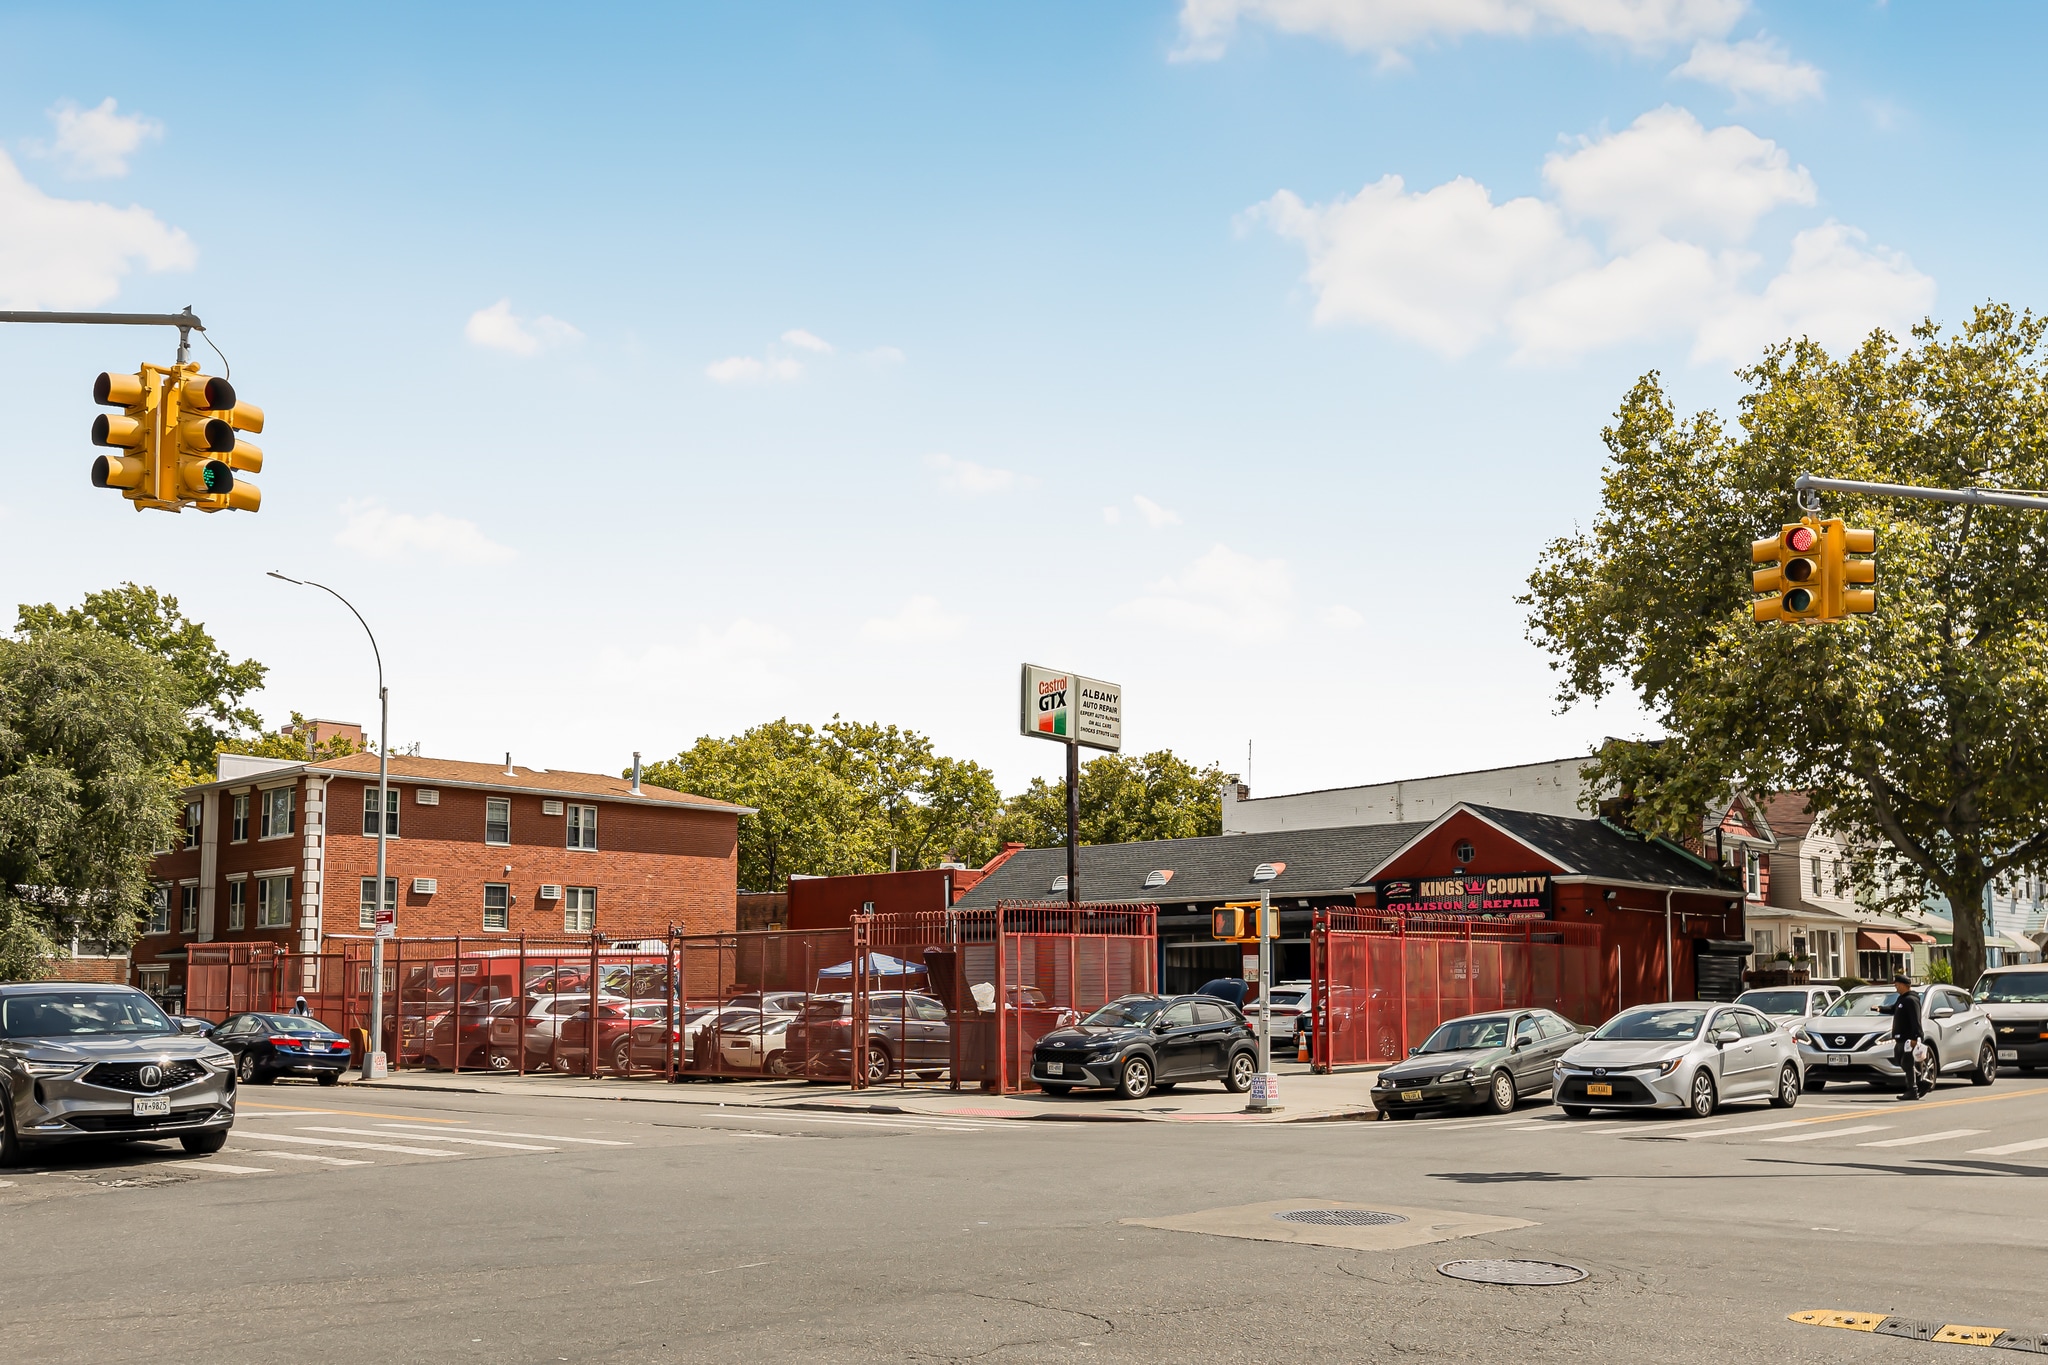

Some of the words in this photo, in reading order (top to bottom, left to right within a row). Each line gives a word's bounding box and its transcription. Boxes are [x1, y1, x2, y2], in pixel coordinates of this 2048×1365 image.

[1039, 676, 1067, 695] Castrol
[1039, 690, 1067, 712] GTX
[1082, 689, 1118, 703] ALBANY
[1083, 701, 1098, 710] AUTO
[1099, 704, 1118, 714] REPAIR
[1080, 726, 1096, 734] SHOCKS
[1096, 729, 1110, 737] STRUTS
[1420, 880, 1465, 897] KINGS
[1486, 876, 1547, 895] COUNTY
[1387, 900, 1462, 912] COLLISION
[1467, 900, 1478, 909] &
[1482, 898, 1540, 909] REPAIR
